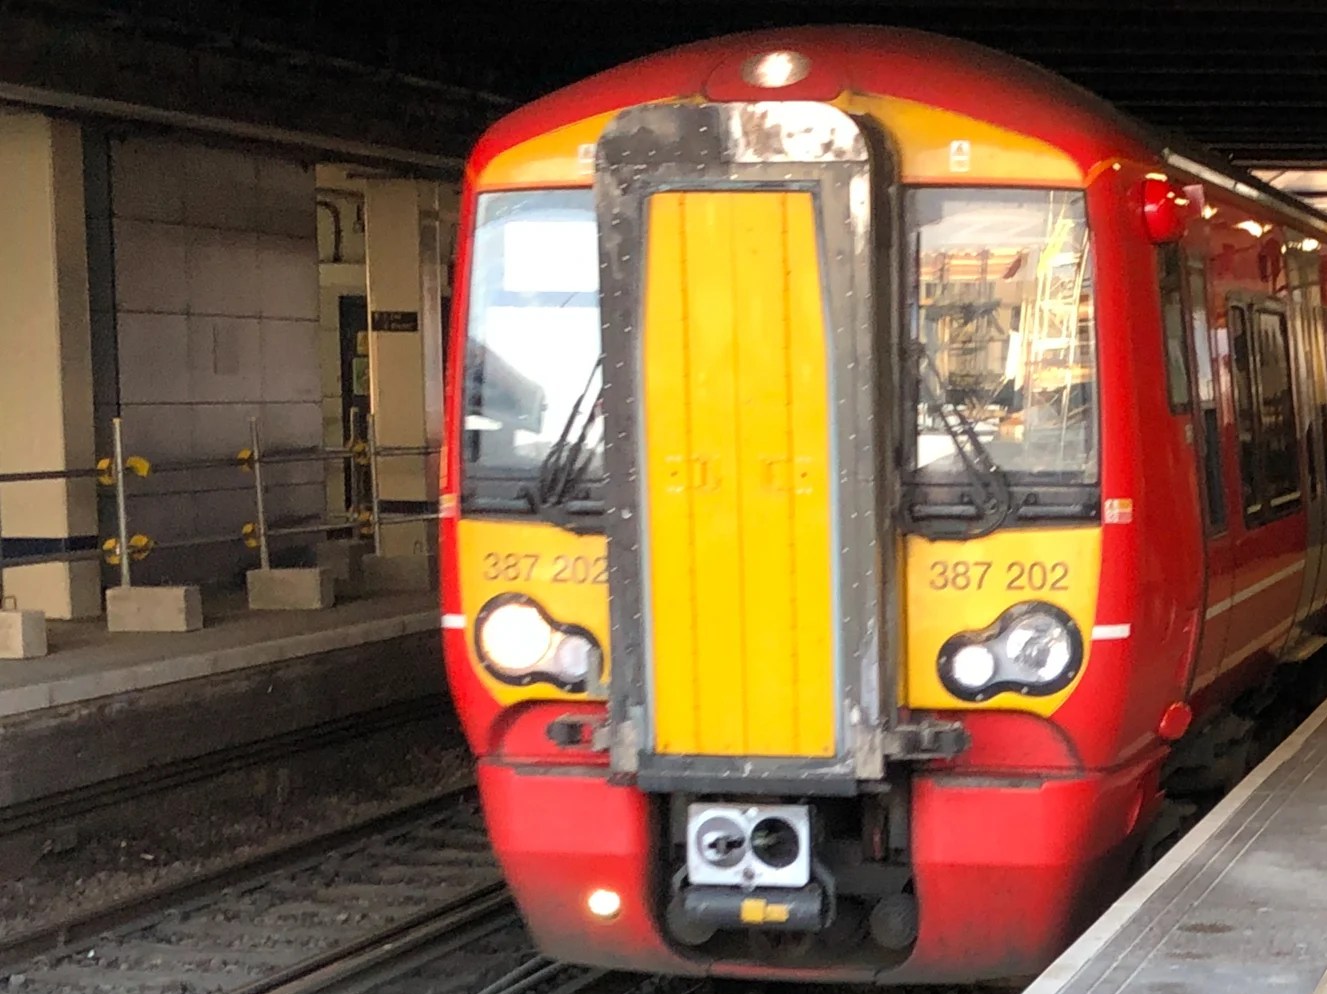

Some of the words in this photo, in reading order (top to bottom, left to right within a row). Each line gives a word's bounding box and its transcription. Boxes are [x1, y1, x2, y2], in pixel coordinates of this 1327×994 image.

[483, 551, 540, 581] 387
[551, 555, 609, 585] 202
[929, 560, 993, 591] 387
[1005, 561, 1069, 592] 202
